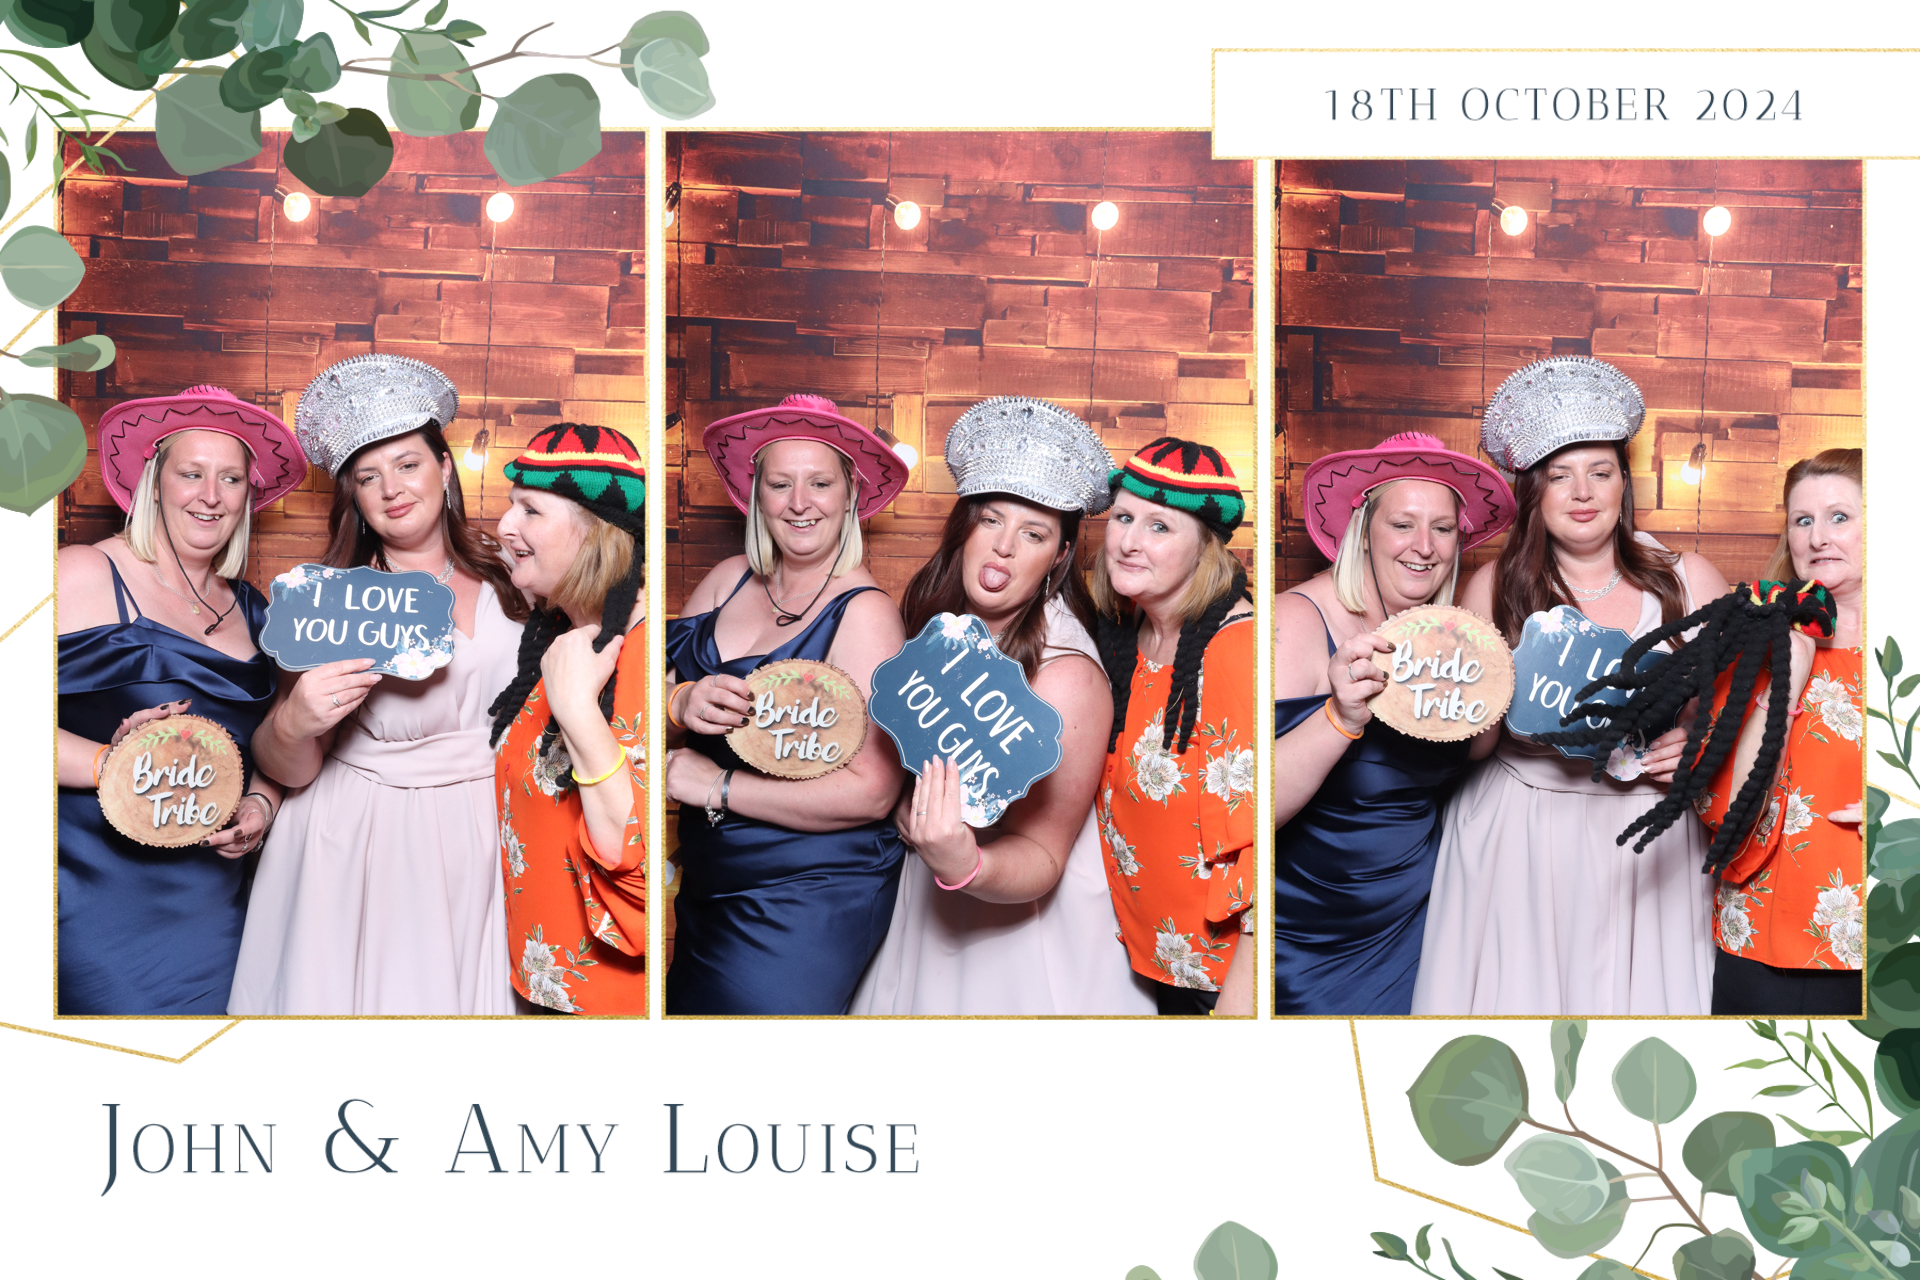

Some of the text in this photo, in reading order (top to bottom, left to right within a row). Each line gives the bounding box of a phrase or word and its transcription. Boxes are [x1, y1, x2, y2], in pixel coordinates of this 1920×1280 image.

[313, 582, 419, 613] I LOVE
[294, 618, 430, 651] YOU GUYS
[1558, 635, 1574, 666] I
[1392, 639, 1484, 683] Bride
[755, 690, 839, 728] Bride
[898, 670, 949, 729] YOU
[941, 647, 1034, 755] I LOVE
[1406, 683, 1489, 723] Tribe
[1529, 673, 1580, 718] YOU
[768, 728, 843, 762] Tribe
[133, 751, 217, 794] Bride
[146, 792, 221, 828] Tribe
